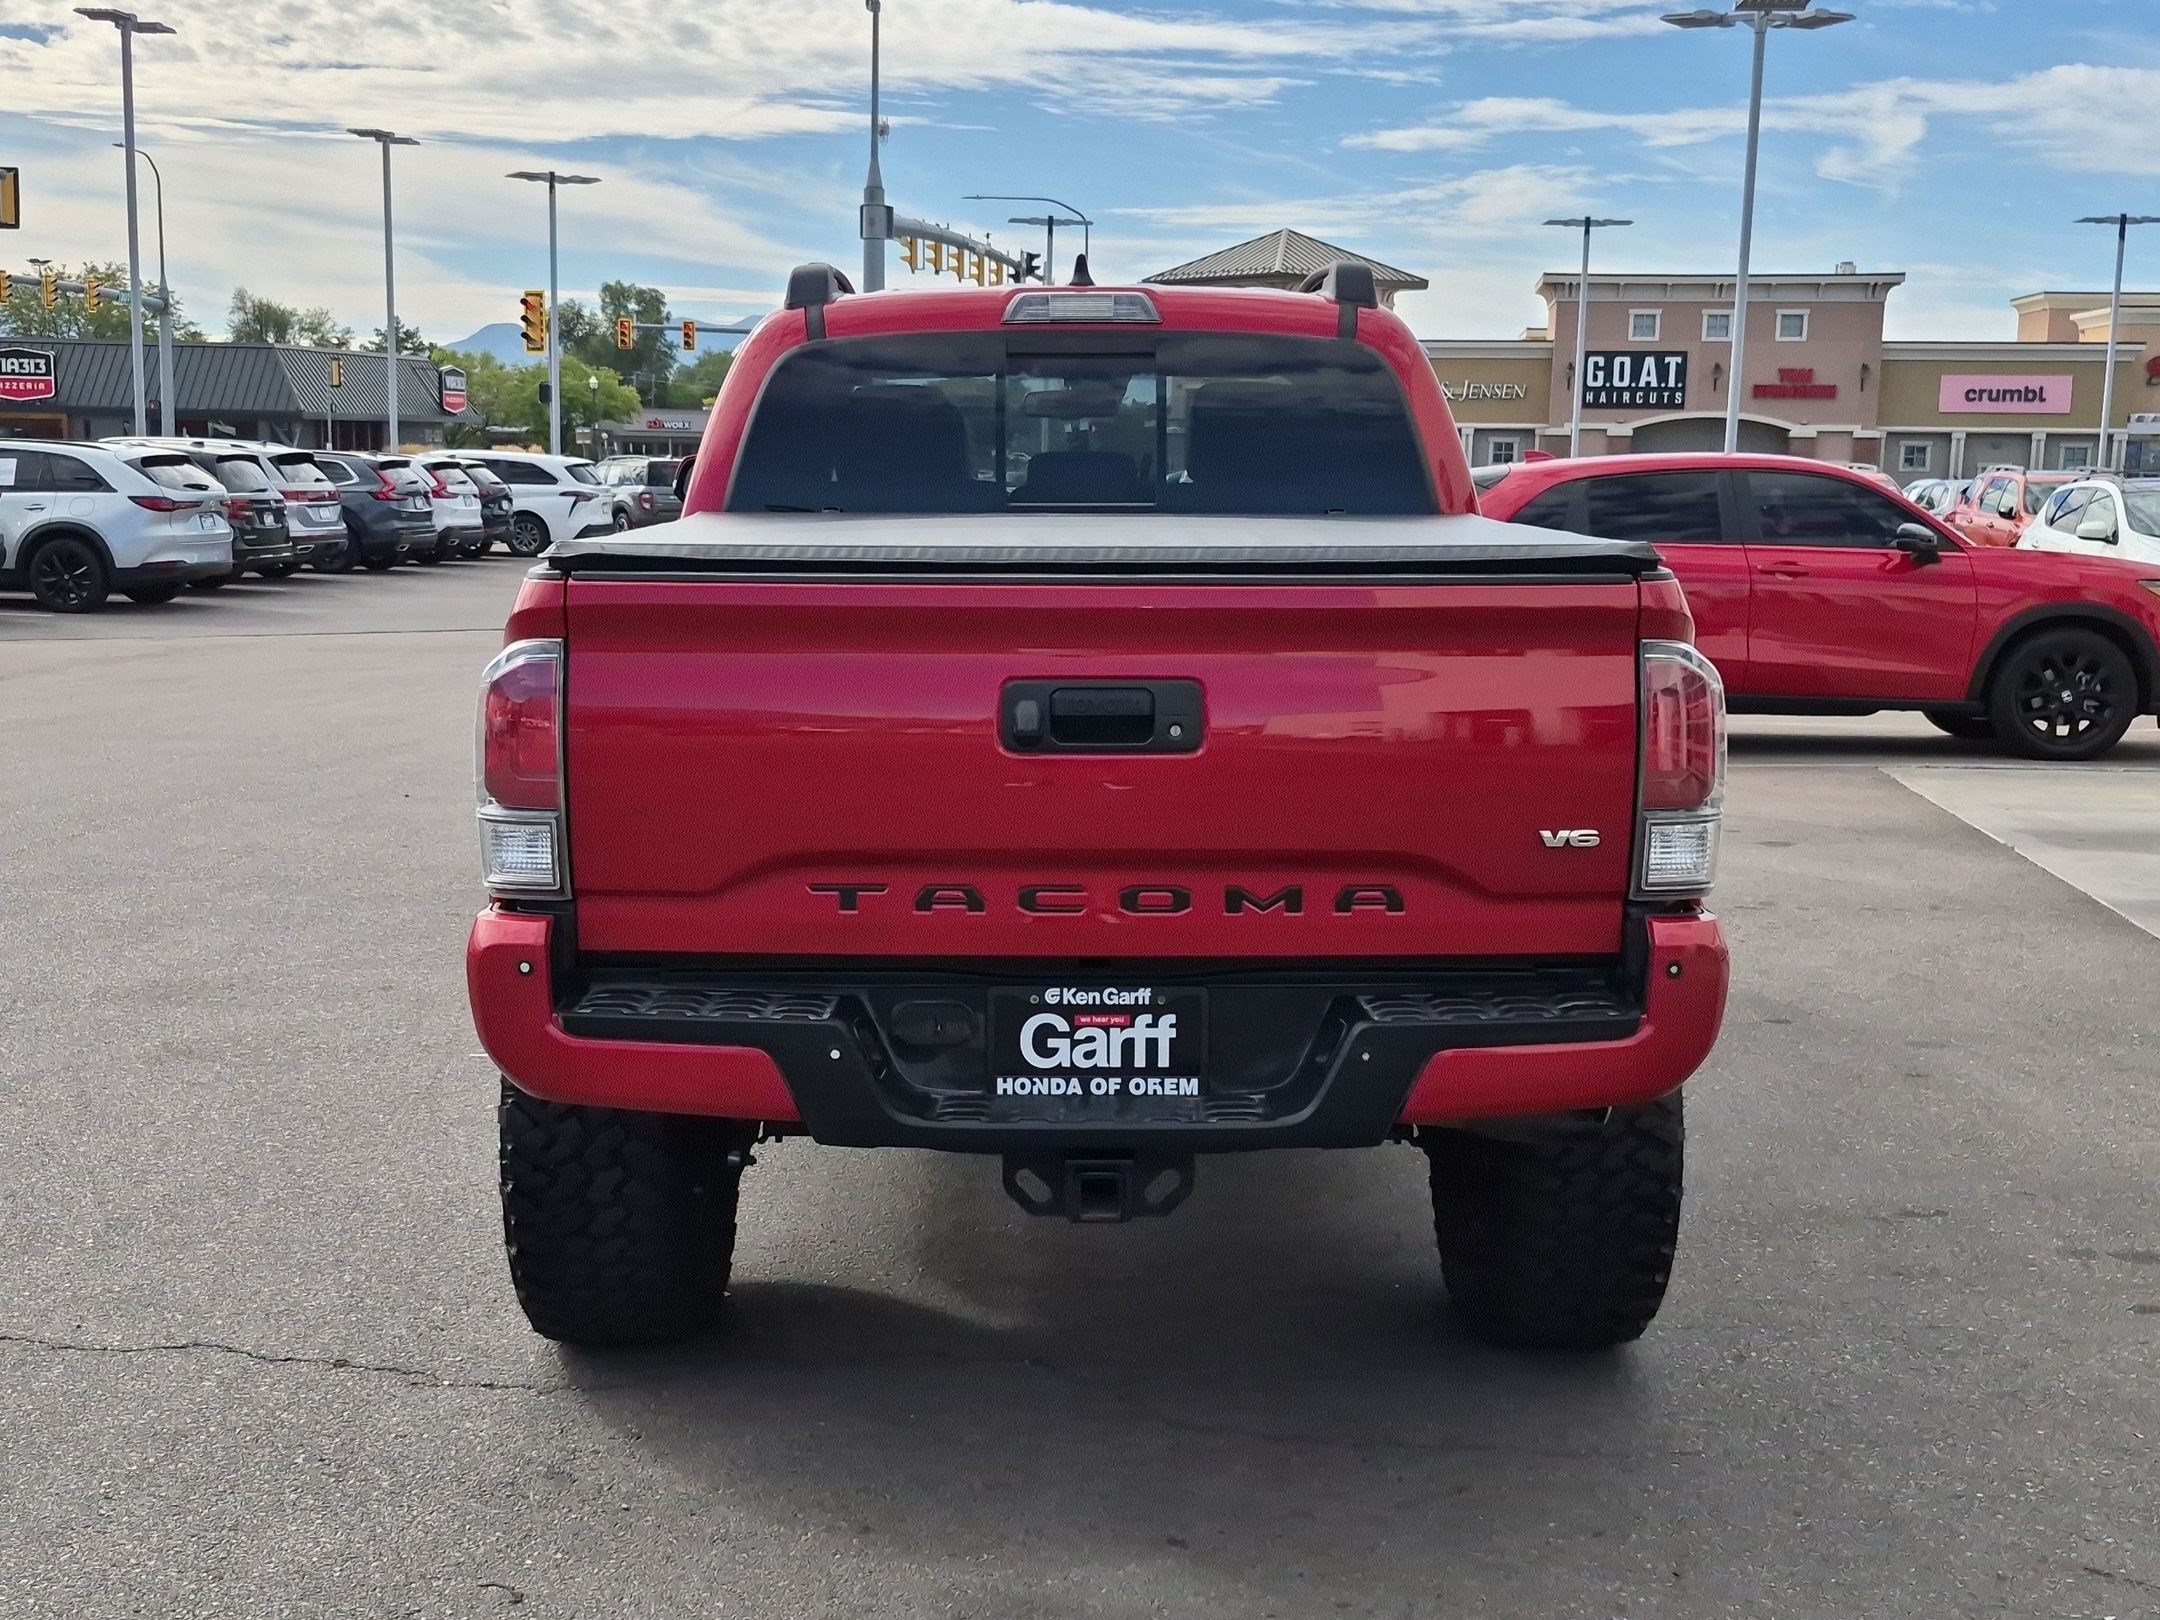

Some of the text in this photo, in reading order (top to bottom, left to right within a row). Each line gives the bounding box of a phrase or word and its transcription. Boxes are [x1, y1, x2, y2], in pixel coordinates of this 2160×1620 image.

[0, 358, 46, 373] IA313
[1586, 356, 1682, 388] G.O.A.T.
[0, 382, 45, 390] IZZERIA
[1965, 386, 2046, 403] crumbl
[1586, 391, 1682, 404] HAIRCUTS
[1539, 829, 1601, 847] V6
[806, 884, 1406, 917] TACOMA
[1062, 987, 1151, 1005] Ken Garff
[1019, 1012, 1177, 1068] Garff
[996, 1077, 1199, 1095] HONDA OF OREM
